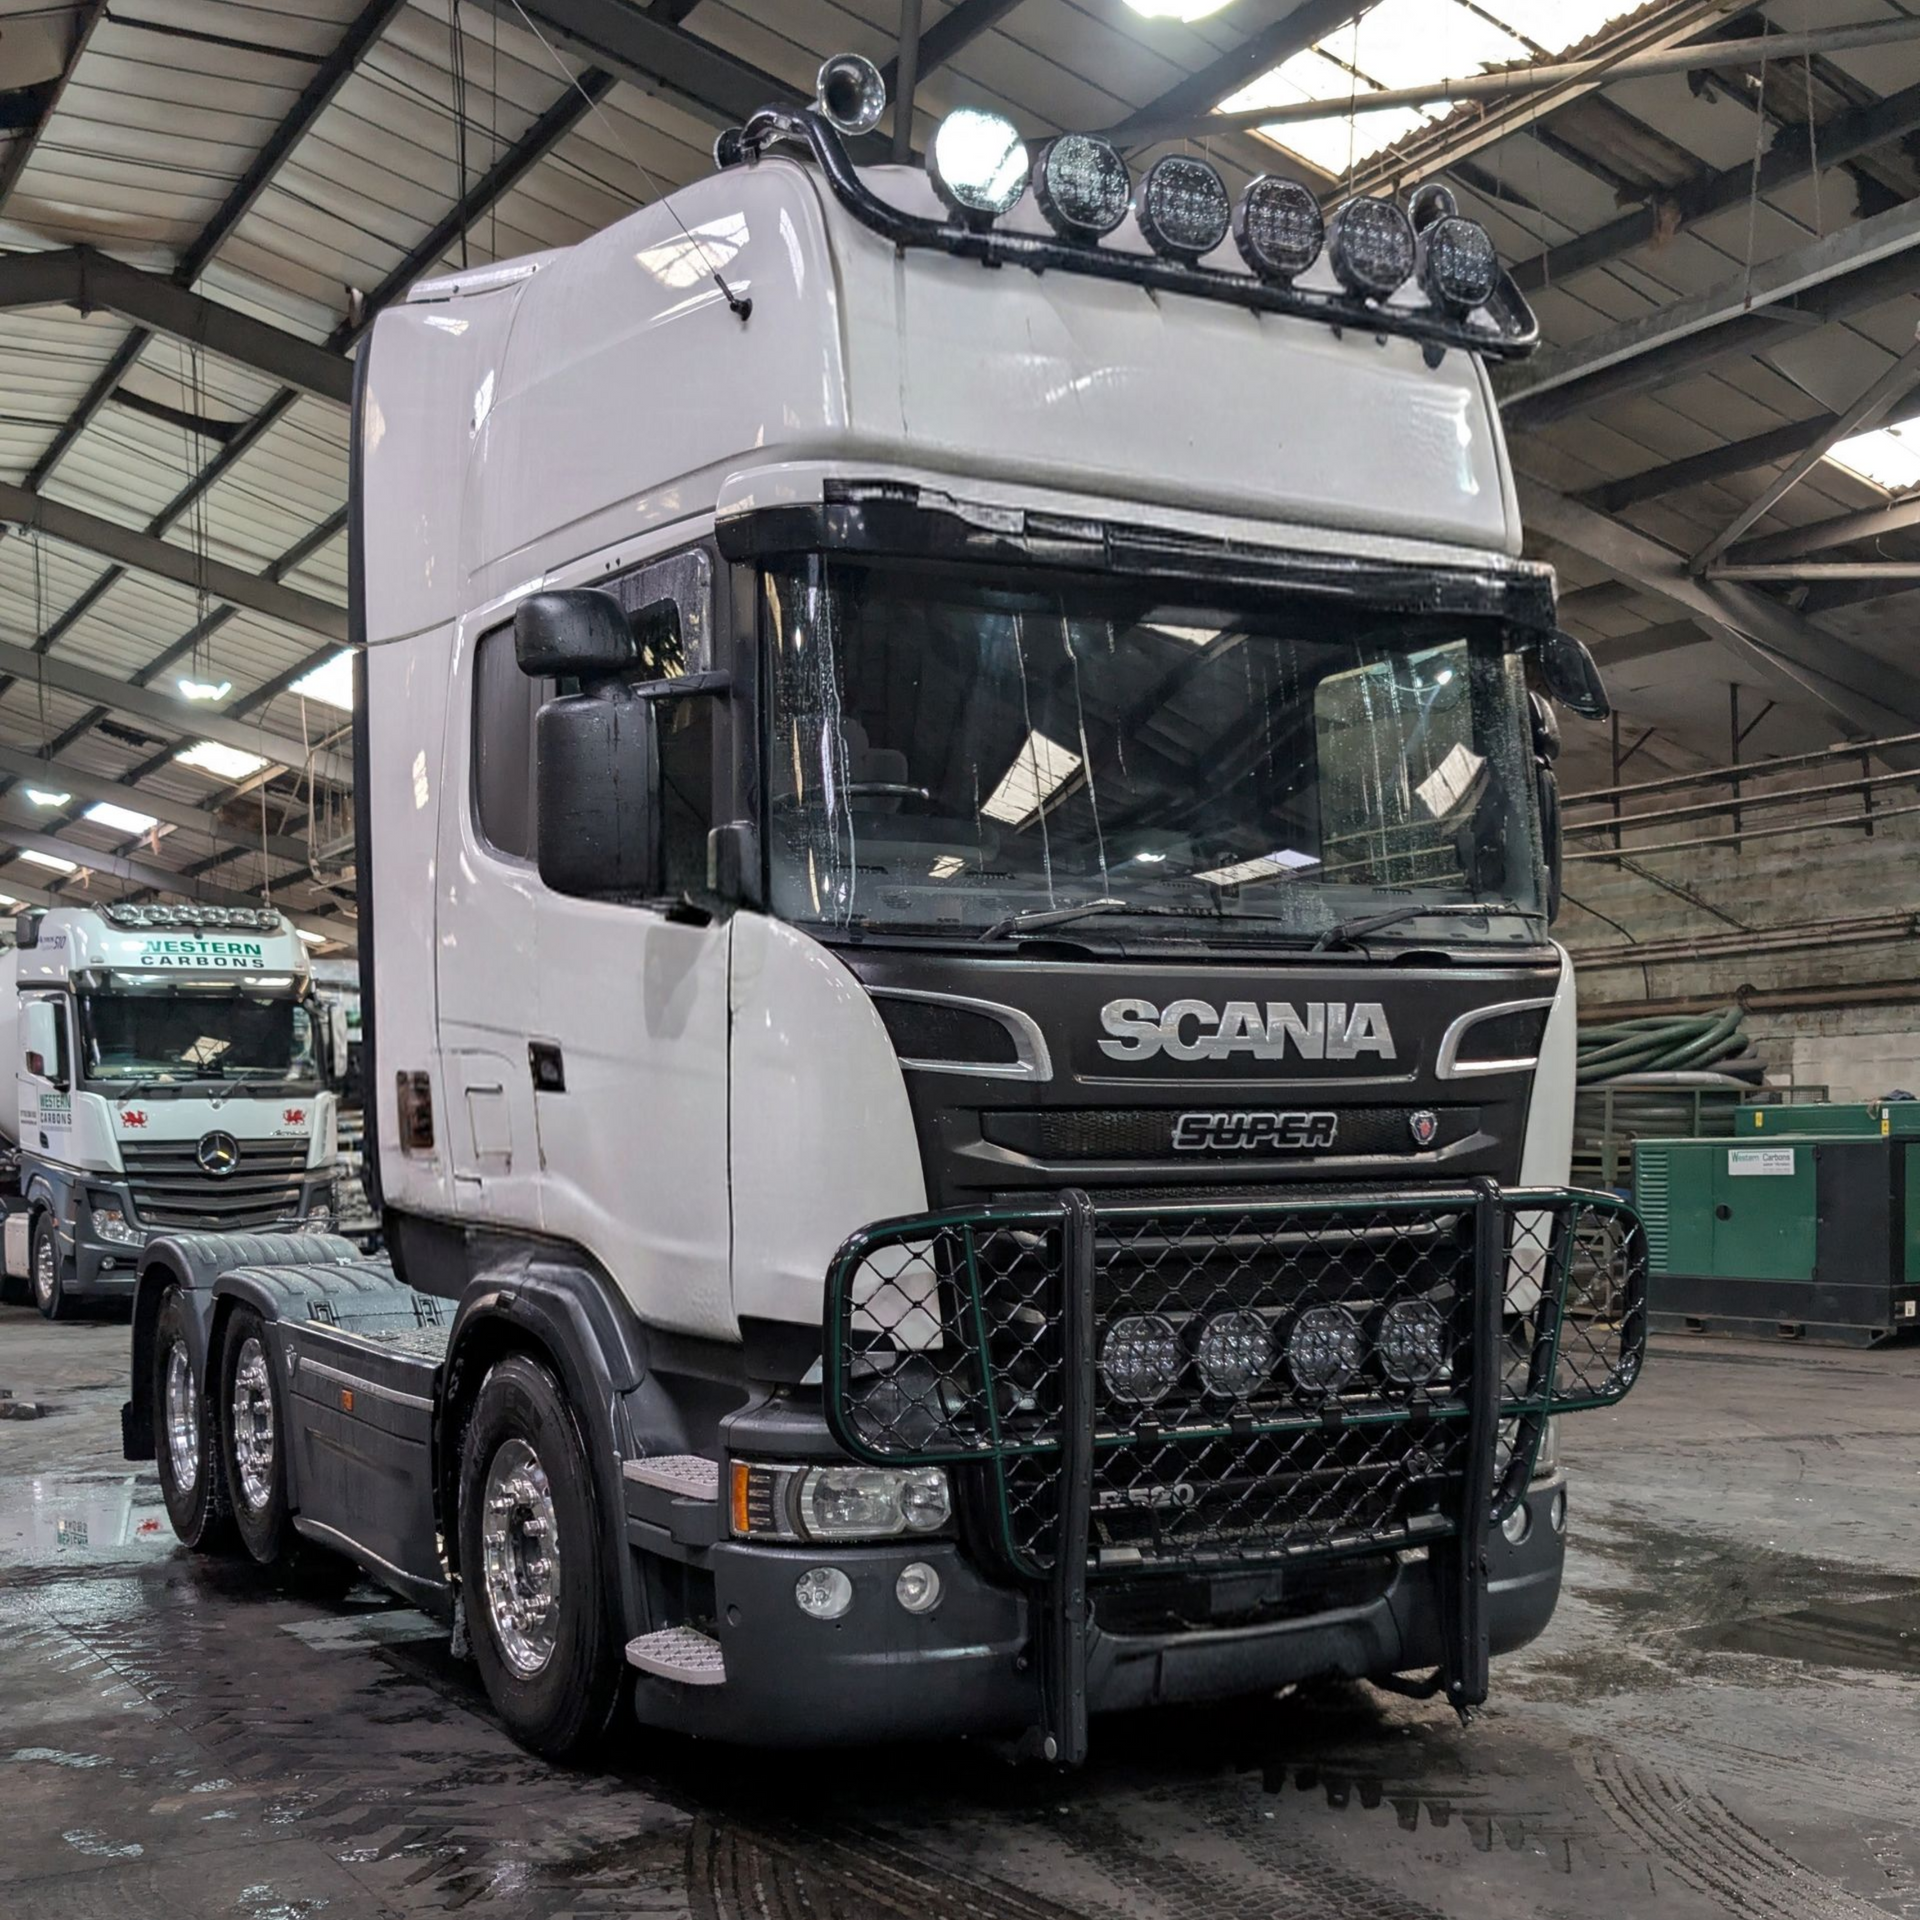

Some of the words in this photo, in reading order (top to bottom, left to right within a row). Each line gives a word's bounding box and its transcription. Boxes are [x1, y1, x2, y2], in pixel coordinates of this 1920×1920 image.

[140, 955, 265, 968] CARBONS
[1097, 998, 1397, 1062] SCANIA
[40, 1112, 72, 1125] CARBONS
[1171, 1112, 1338, 1151] SUPER
[1762, 1153, 1791, 1162] Carbons
